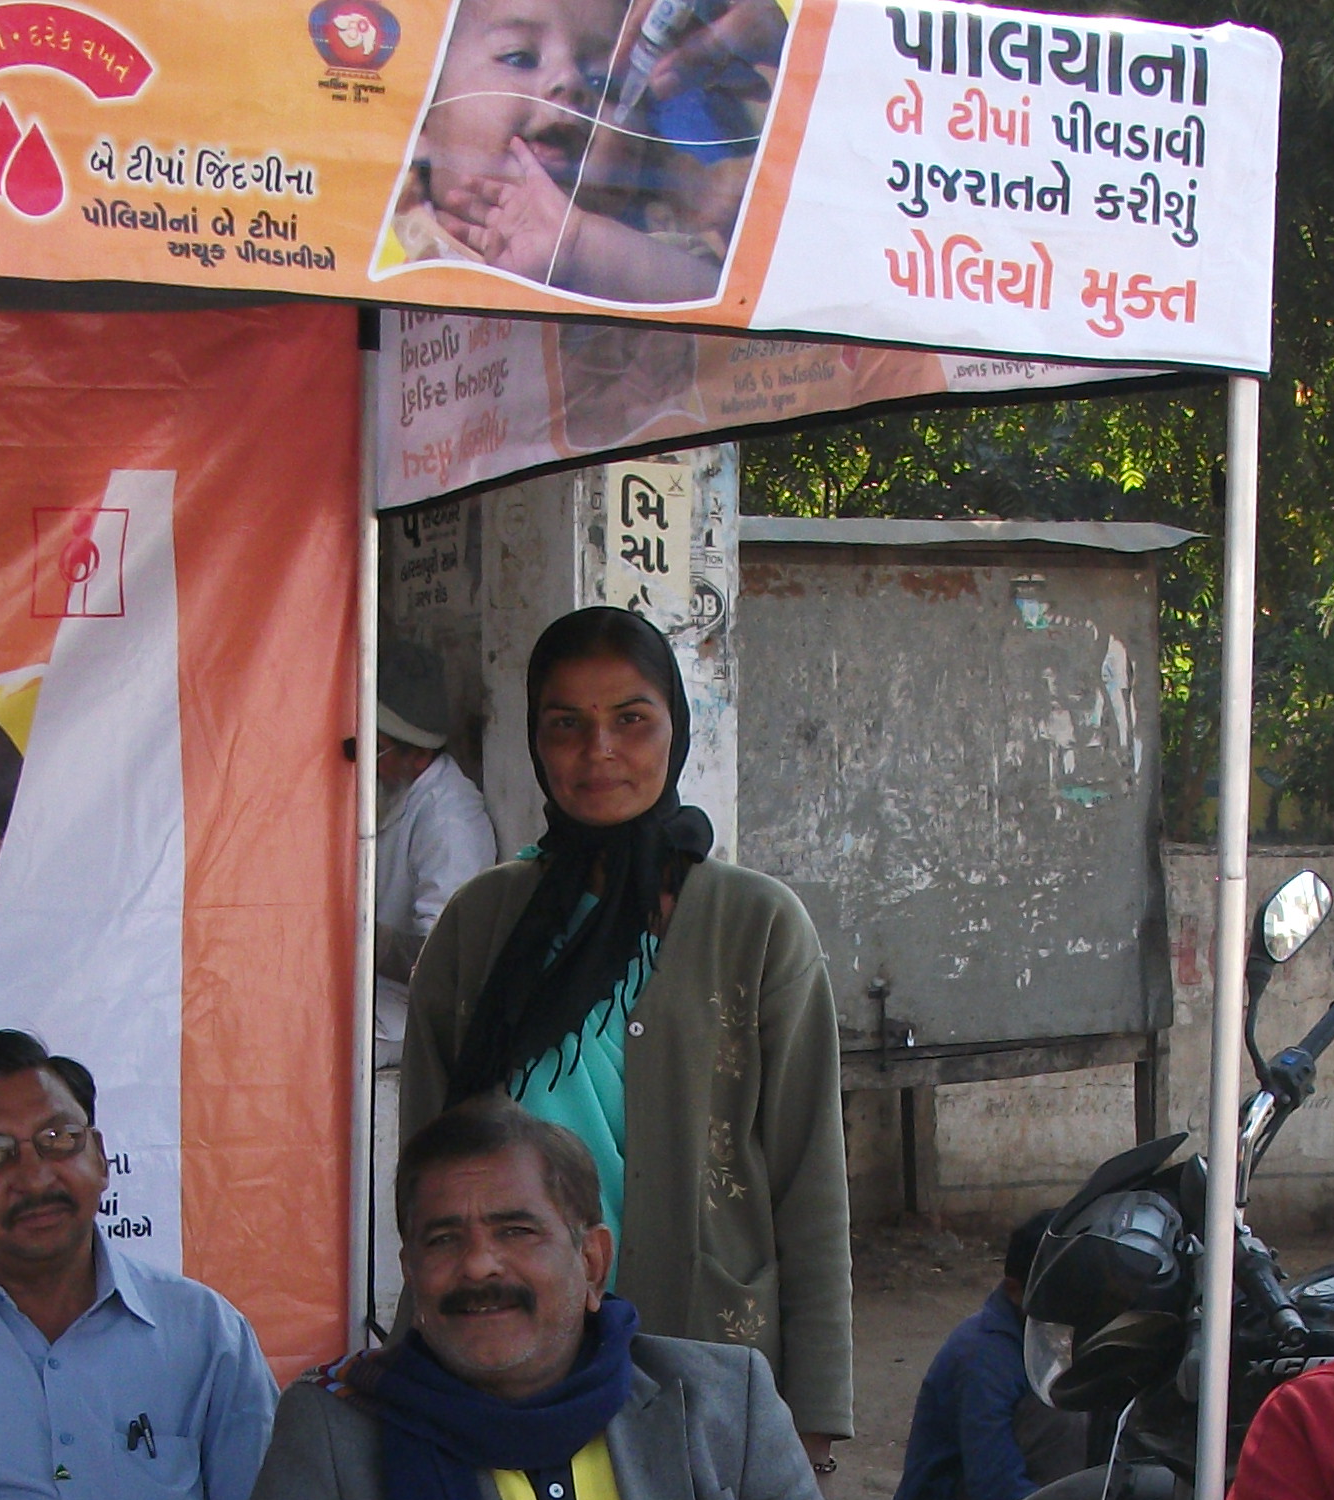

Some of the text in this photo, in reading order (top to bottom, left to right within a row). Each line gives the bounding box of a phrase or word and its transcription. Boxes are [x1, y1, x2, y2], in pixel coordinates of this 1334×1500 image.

[886, 79, 1206, 168] બે ટીપાં પીવડાવી
[90, 141, 314, 195] બે ટીપાં જિંદગીના
[886, 159, 1199, 248] ગુજરાતને કરીશું
[81, 198, 298, 242] પોલિયોનાં બે ટીપાં
[167, 240, 336, 271] અચૂક પીવડાવીએ
[885, 229, 1198, 338] પોલિયો મુક્ત
